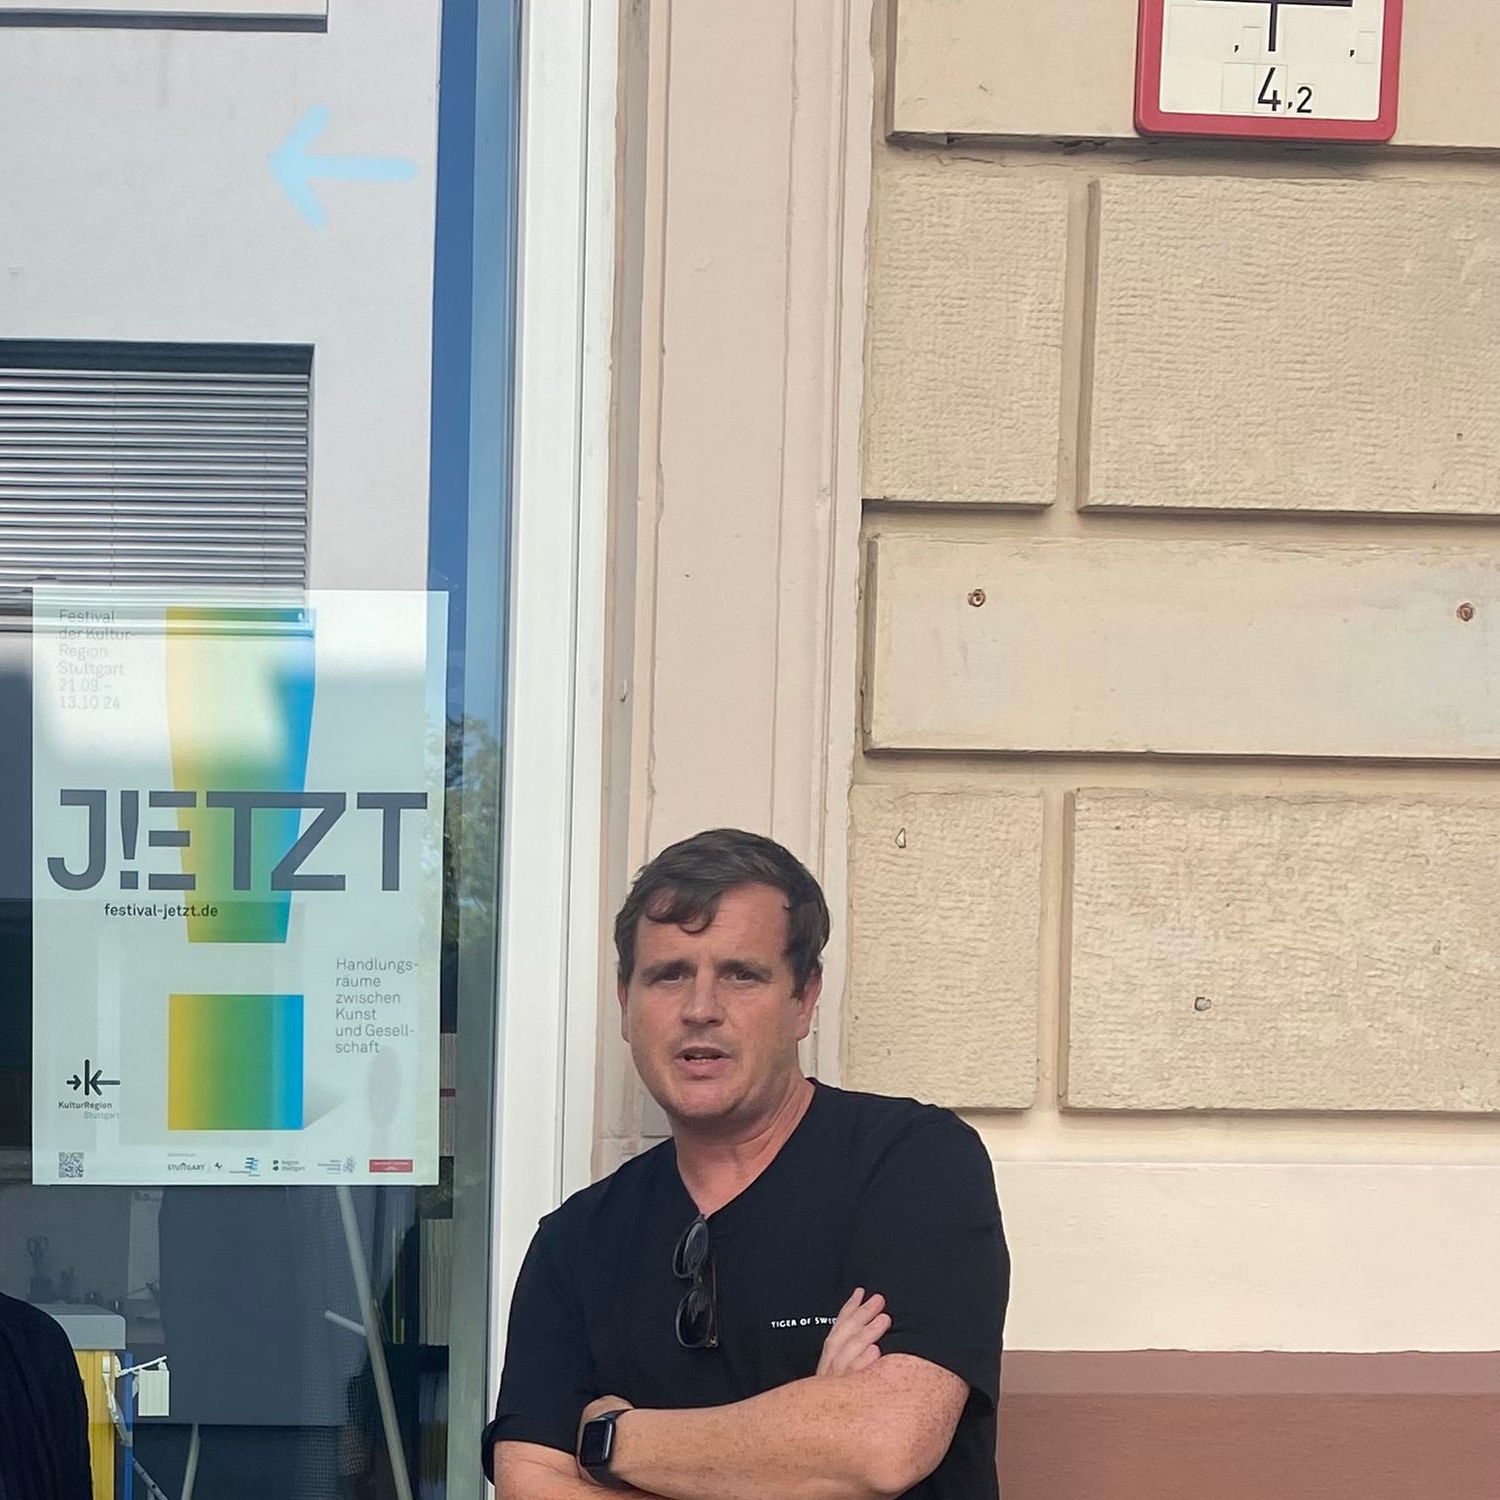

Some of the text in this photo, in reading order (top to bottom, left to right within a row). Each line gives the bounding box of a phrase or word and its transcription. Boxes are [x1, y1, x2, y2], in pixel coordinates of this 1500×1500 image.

[59, 608, 115, 623] Festival
[58, 626, 83, 640] der
[59, 643, 108, 661] Region
[58, 660, 125, 679] Stuttgart
[104, 902, 219, 920] festival-jetzt.de
[336, 957, 420, 974] Handlungs-
[335, 974, 381, 987] räume
[335, 991, 401, 1004] zwischen
[335, 1007, 378, 1020] Kunst
[335, 1023, 415, 1037] und Gesell-
[334, 1039, 380, 1053] schaft
[58, 1101, 113, 1111] KulturRegion
[83, 1111, 120, 1121] Stuttgart
[771, 1320, 797, 1328] TIGER
[799, 1318, 811, 1326] OF
